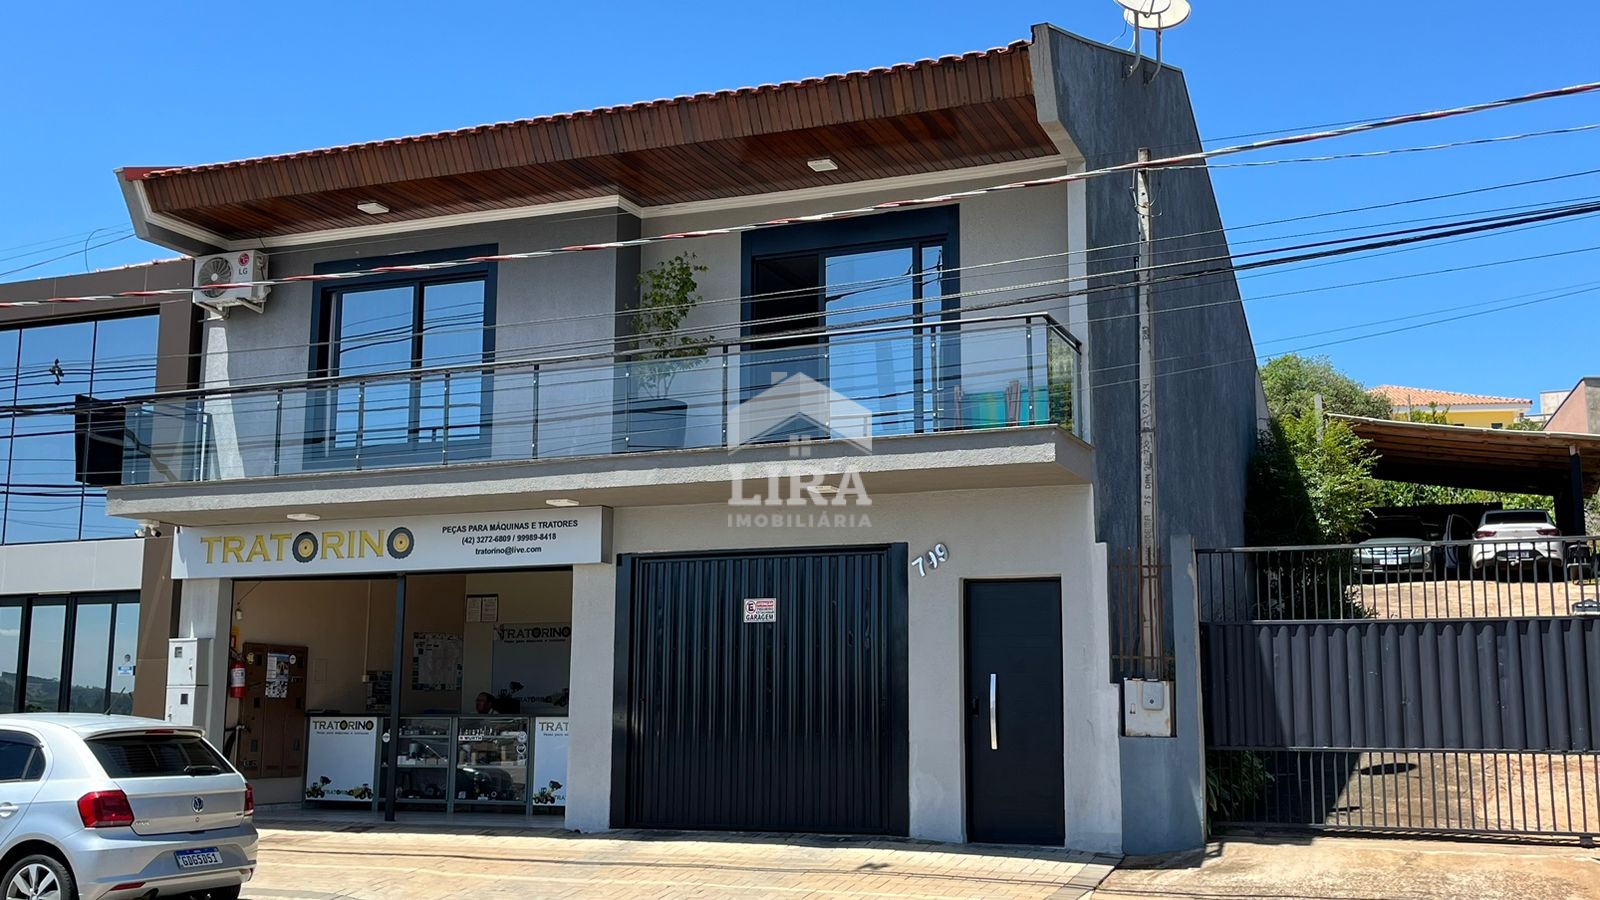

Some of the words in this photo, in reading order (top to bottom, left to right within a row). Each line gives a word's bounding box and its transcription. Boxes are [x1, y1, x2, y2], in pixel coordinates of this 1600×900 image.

[238, 267, 248, 275] LG
[442, 524, 467, 534] PEÇAS
[468, 523, 489, 532] PARA
[489, 521, 530, 531] MÁQUINAS
[531, 521, 537, 530] E
[538, 519, 579, 529] TRATORES
[200, 526, 415, 564] TRATORINO
[461, 536, 475, 545] (42)
[475, 546, 542, 556] tratorino@live.com
[501, 626, 571, 639] TRATORINO
[312, 720, 374, 731] TRATORINO
